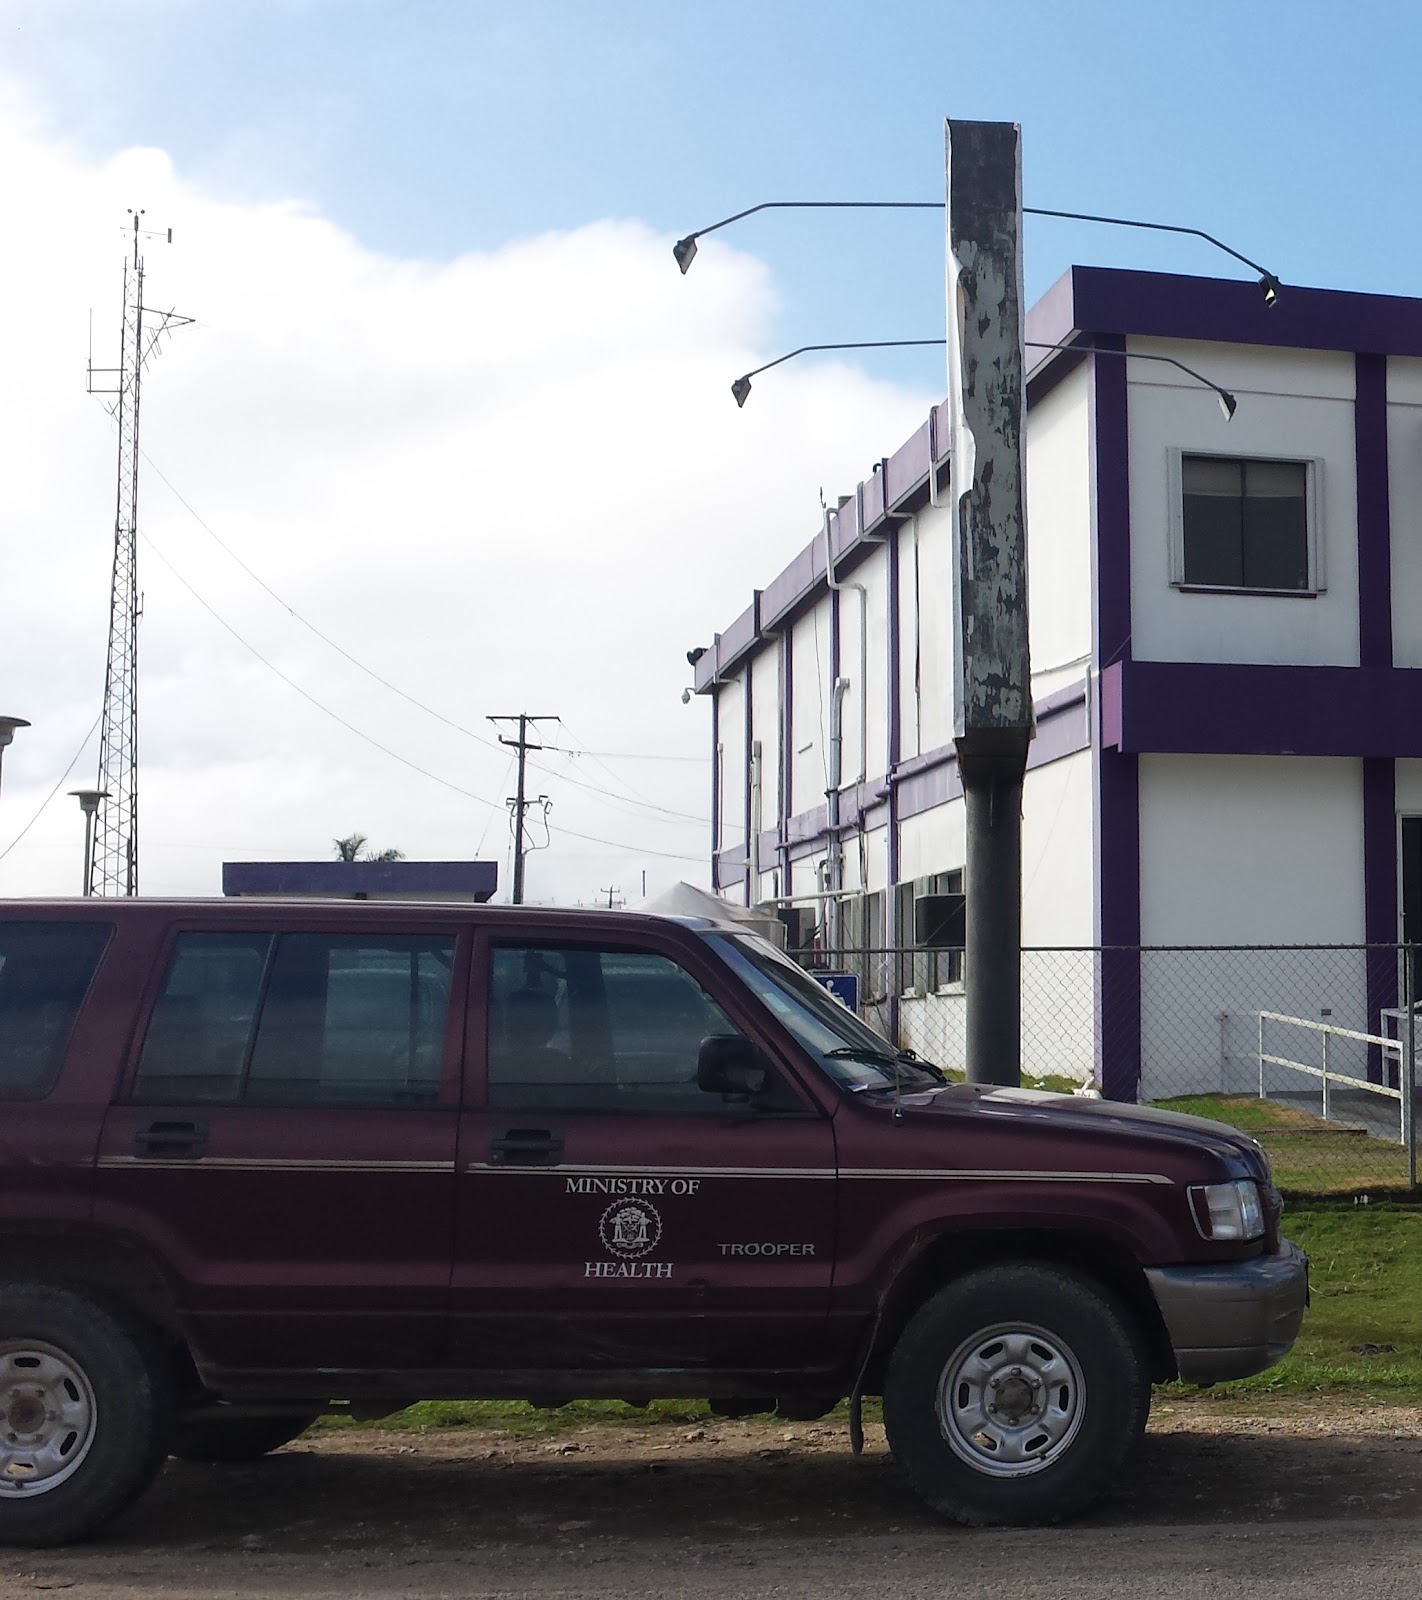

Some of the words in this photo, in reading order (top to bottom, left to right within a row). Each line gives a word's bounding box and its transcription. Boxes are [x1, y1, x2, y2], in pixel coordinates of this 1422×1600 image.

[565, 1177, 669, 1195] MINISTRY
[670, 1179, 701, 1196] OF
[717, 1243, 816, 1256] TROOPER
[584, 1262, 674, 1279] HEALTH
